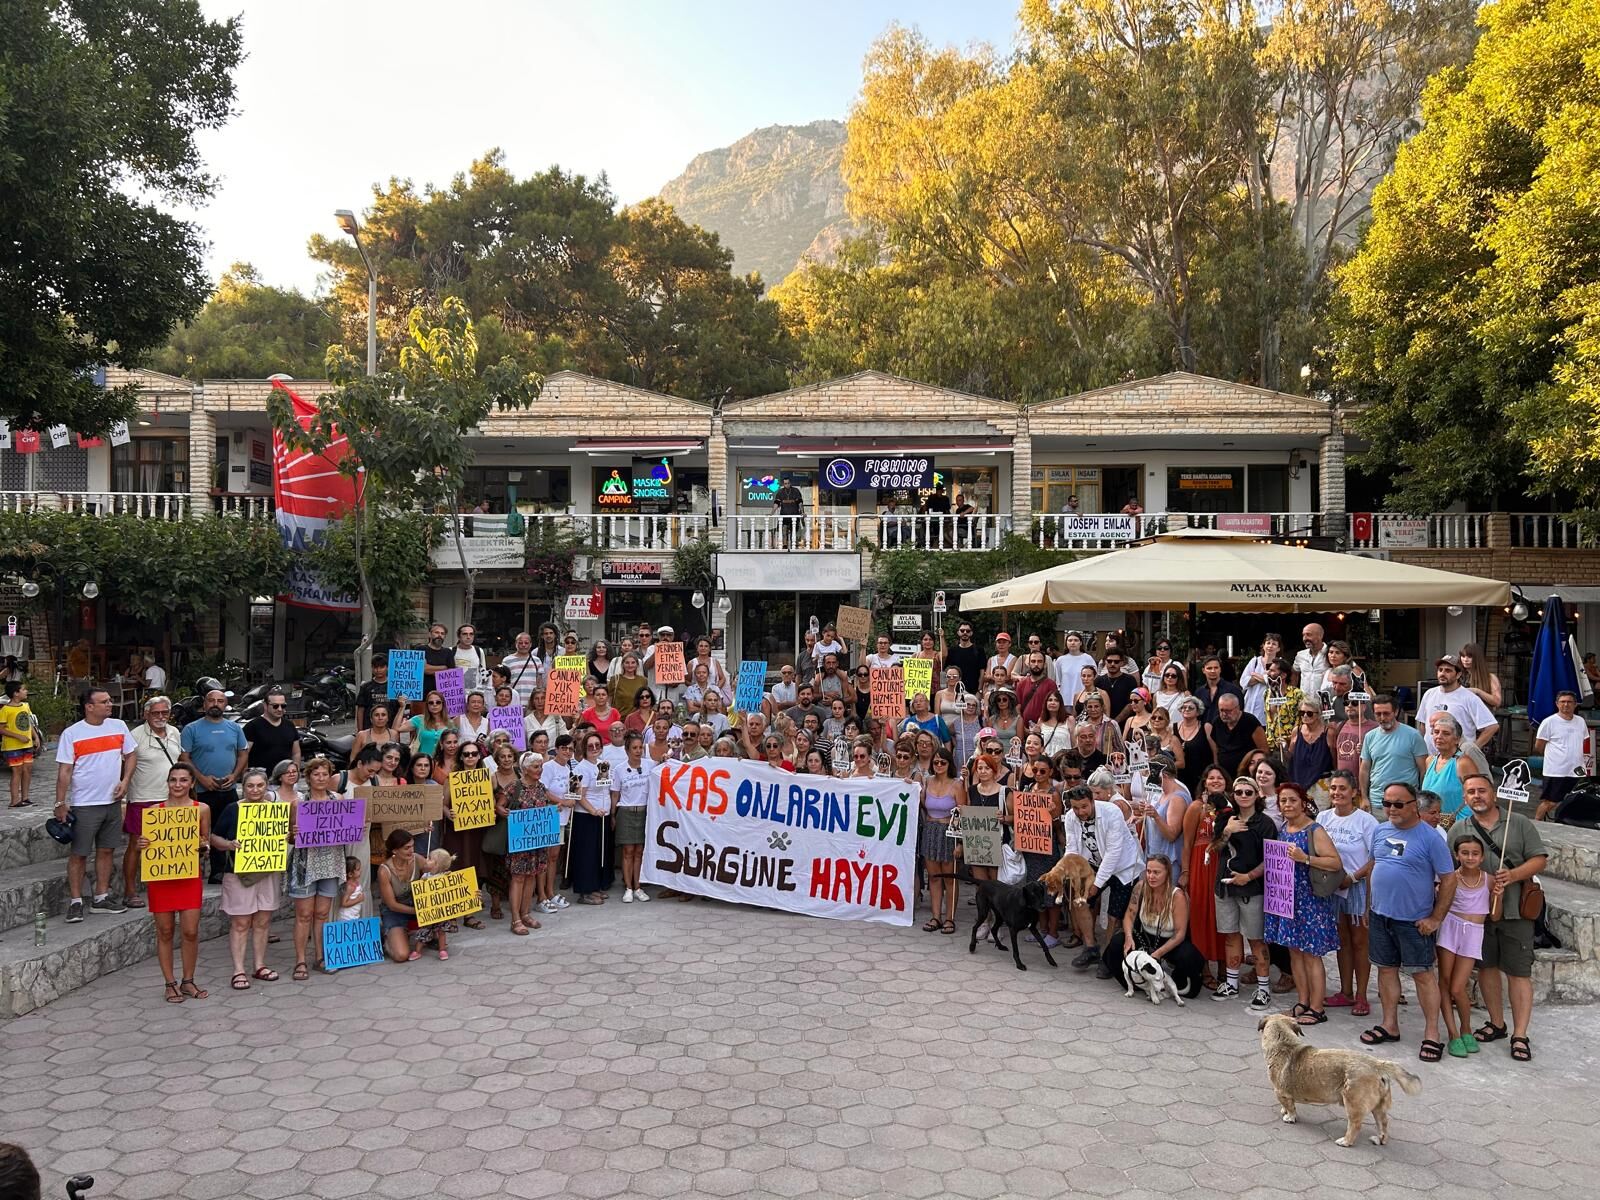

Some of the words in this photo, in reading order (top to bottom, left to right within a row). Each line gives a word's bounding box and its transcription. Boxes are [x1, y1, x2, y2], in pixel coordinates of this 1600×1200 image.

[53, 431, 67, 440] CHP
[865, 459, 928, 472] FISHING
[870, 474, 922, 487] STORE
[598, 495, 632, 503] CAMPING
[633, 489, 669, 497] SNORKEL
[748, 492, 774, 500] DIVING
[1068, 518, 1099, 529] JOSEPH
[1103, 518, 1131, 529] EMLAK
[612, 562, 661, 574] TELEFONCU
[1231, 584, 1271, 592] AYLAK
[1276, 584, 1327, 592] BAKKAL
[392, 651, 425, 661] TOPLAMA
[661, 653, 680, 663] ETME
[394, 661, 418, 671] KAMPI
[549, 670, 580, 682] CANLAR
[662, 672, 683, 681] KORU
[871, 668, 904, 681] CANLARI
[908, 669, 929, 679] ETME
[492, 706, 522, 718] CANLARI
[242, 804, 290, 819] TOPLAMA
[658, 764, 731, 822] KAŞ
[736, 779, 850, 834] ONLARIN
[856, 792, 910, 846] EVİ
[145, 807, 199, 825] SÜRGÜN
[458, 813, 492, 828] HAKKI
[510, 807, 554, 825] TOPLAMA
[148, 825, 199, 843] SUÇTUR
[523, 820, 552, 836] KAMPI
[145, 844, 195, 860] ORTAK
[150, 861, 193, 877] OLMA!
[241, 854, 284, 871] YAŞAT!
[655, 821, 797, 891] SÜRGÜNE
[809, 857, 905, 911] HAYIR
[1265, 870, 1293, 888] CANLAR
[325, 921, 373, 945] BURADA
